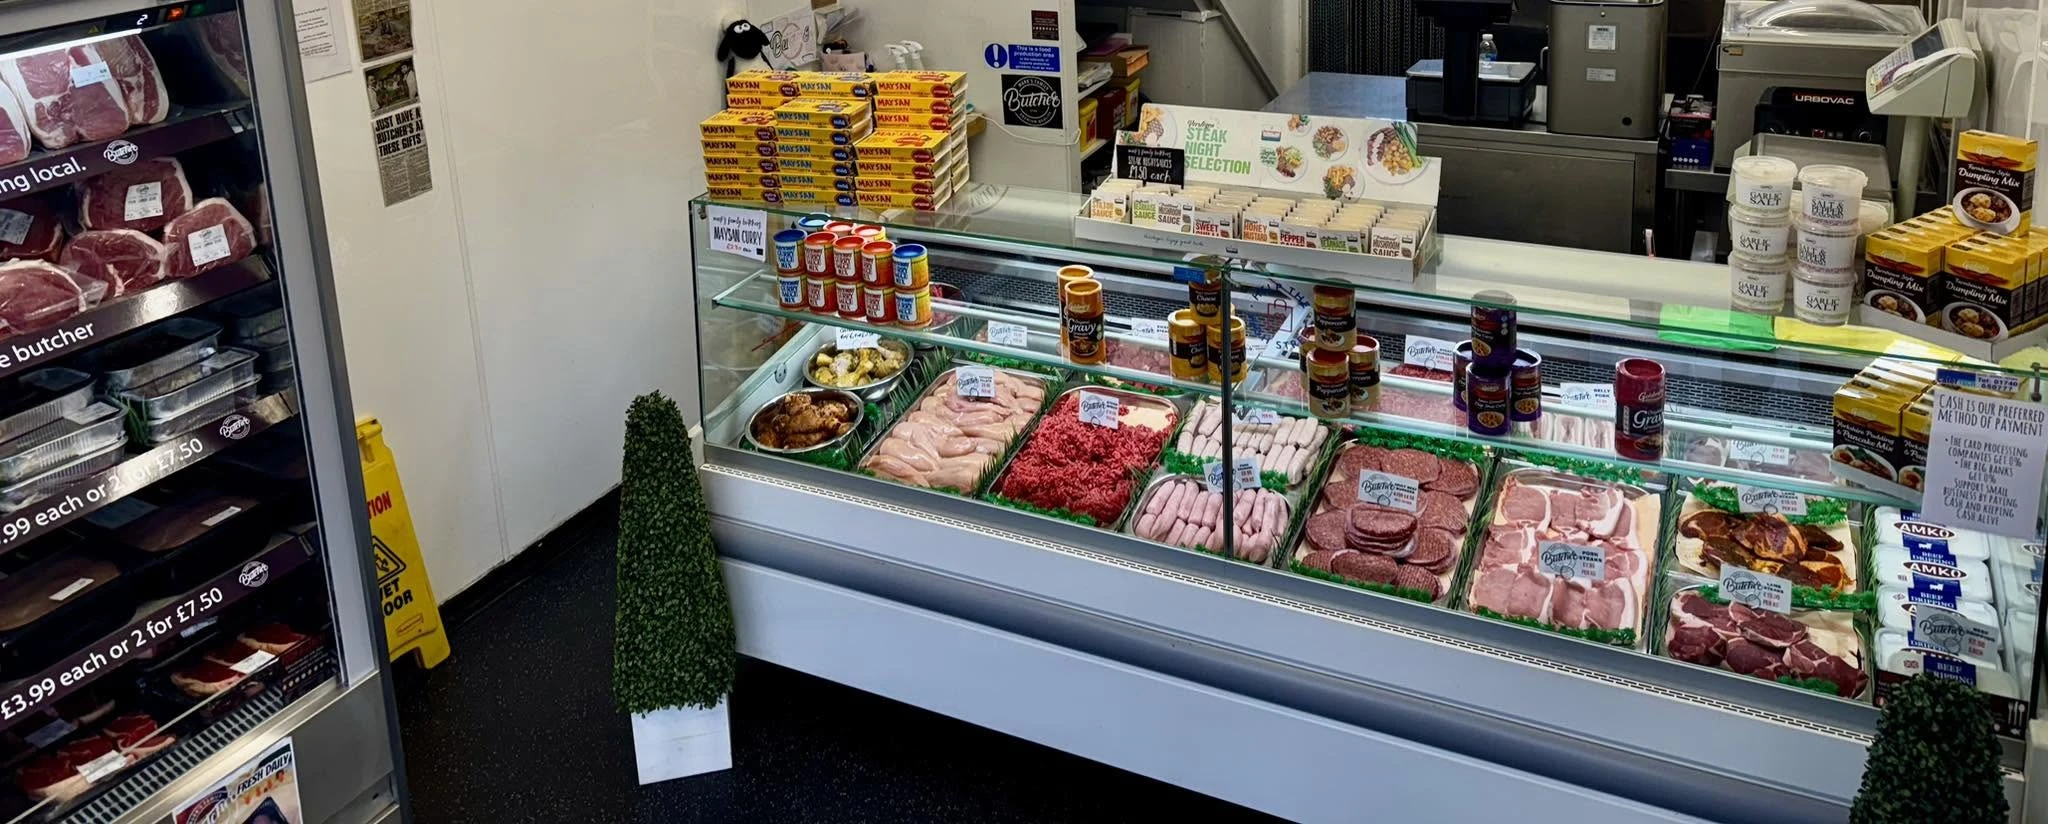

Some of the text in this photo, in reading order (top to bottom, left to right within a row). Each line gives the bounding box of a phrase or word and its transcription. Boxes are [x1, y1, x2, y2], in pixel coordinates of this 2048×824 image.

[376, 108, 421, 132] JUST HAVE A
[376, 123, 414, 144] BUTCHER'S
[1186, 127, 1228, 143] STEAK
[378, 133, 422, 156] THESE GIFTS
[1185, 141, 1222, 156] NIGHT
[29, 156, 87, 183] local.
[1184, 155, 1251, 175] SELECTION
[1151, 170, 1171, 182] each
[1958, 168, 2020, 187] Dumpling Mix
[1750, 191, 1782, 200] GARLIC
[1092, 209, 1113, 218] SAUCE
[1134, 210, 1156, 220] SAUCE
[1812, 206, 1844, 216] PEPPER
[1158, 215, 1181, 225] SAUCE
[1196, 223, 1219, 233] SWEET
[1244, 224, 1268, 233] HONEY
[714, 226, 762, 246] MAYSAN CURRY
[1280, 232, 1305, 245] PEPPER
[1740, 236, 1770, 244] GARLIC
[1740, 242, 1770, 252] SALT
[1739, 281, 1769, 290] GARLIC
[1867, 269, 1924, 293] Dumpling Mix
[1739, 288, 1768, 298] SALT
[1806, 295, 1839, 304] GARLIC
[1946, 280, 2007, 305] Dumpling Mix
[1806, 303, 1839, 311] SALT
[1068, 318, 1096, 335] Gravy
[12, 321, 96, 362] butcher
[1940, 394, 2044, 423] CASH IS OUR PREFERRED
[1938, 409, 2042, 436] METHOD OF PAYMENT
[1836, 420, 1894, 444] Yorkshire Pudding
[1842, 430, 1875, 446] Pancake
[1876, 441, 1894, 452] Mix
[1950, 435, 2028, 458] THE CARD PROCESSING
[1948, 447, 2022, 467] COMPANIES GET 0%
[1960, 459, 2013, 477] THE BIG BANKS
[35, 496, 84, 526] each
[86, 484, 106, 502] or
[108, 475, 123, 492] 2
[156, 438, 203, 471] £7.50
[1969, 472, 1996, 484] GET 0%
[1954, 478, 2008, 497] SUPPORT SMALL
[367, 492, 392, 519] TION
[1943, 487, 2017, 508] BUSINESS BY PAYING
[1944, 496, 2014, 518] CASH AND KEEPING
[1956, 509, 1999, 525] CASH ALIVE
[1900, 524, 1950, 538] AMKO
[1913, 555, 1955, 566] DRIPPING
[1910, 563, 1962, 578] AMKO
[384, 589, 413, 616] OOR
[1910, 596, 1954, 608] DRIPPING
[1, 587, 223, 720] £3.99 each or 2 for £7.50
[1937, 663, 1962, 672] BEEF
[1932, 671, 1974, 685] RIPPING
[237, 752, 290, 795] FRESH DAILY
